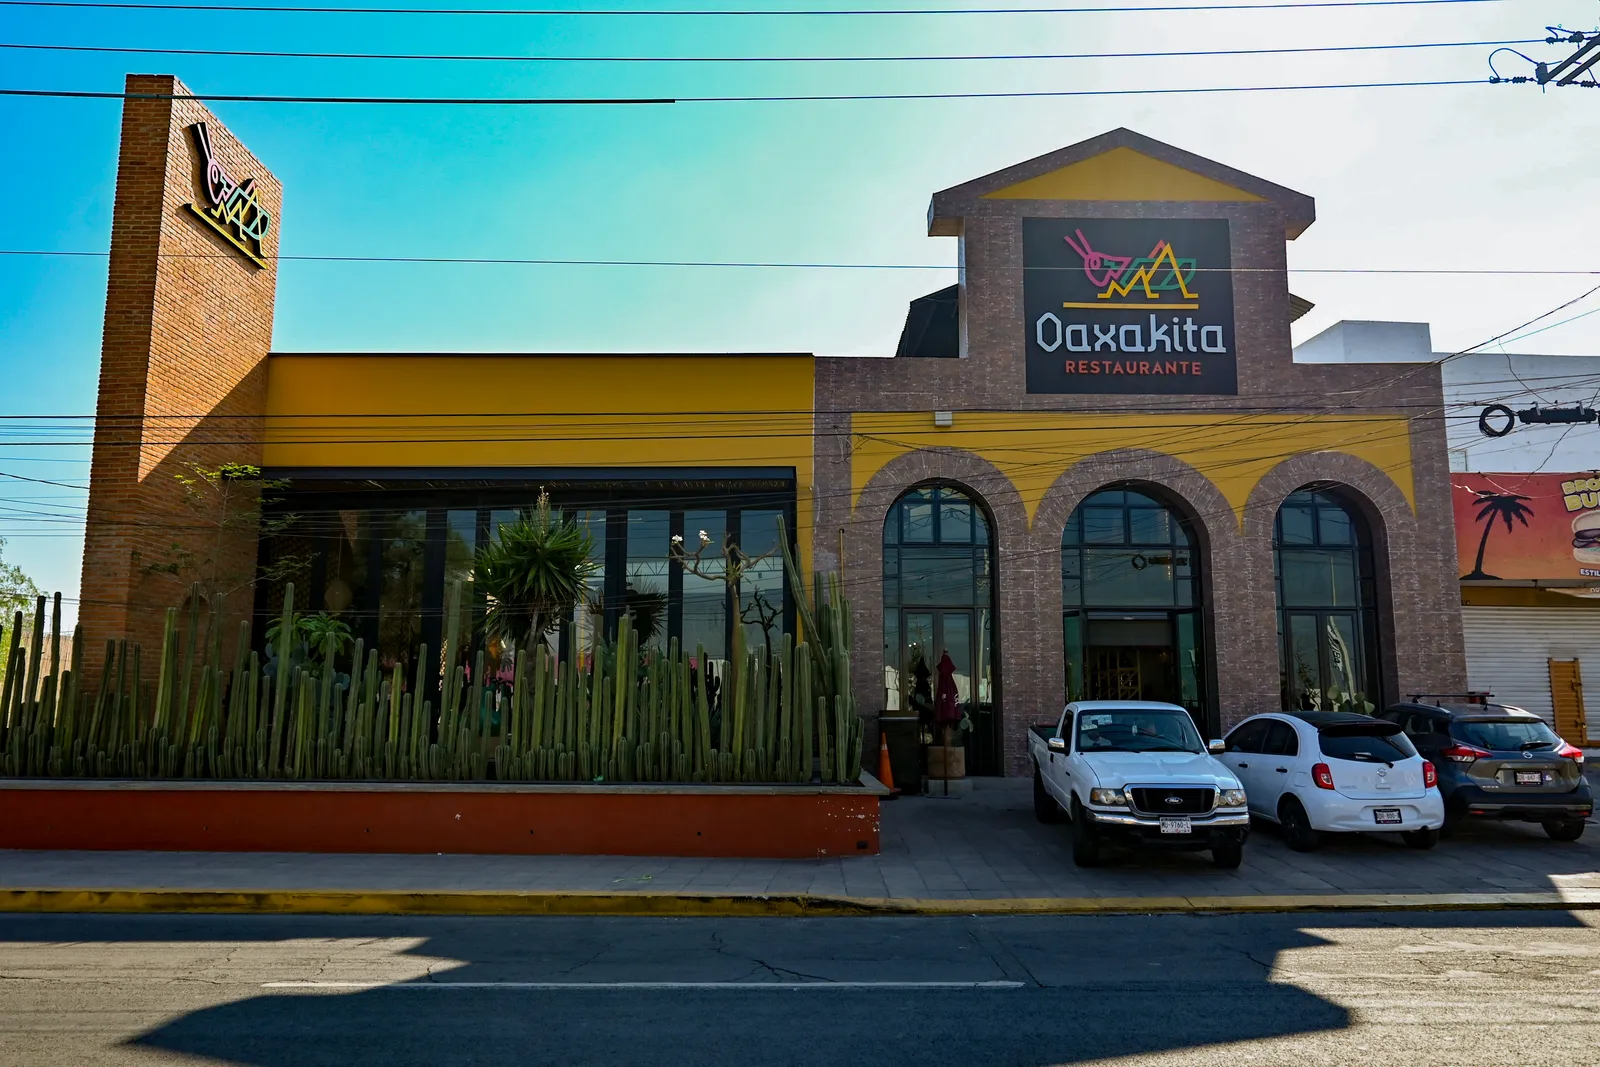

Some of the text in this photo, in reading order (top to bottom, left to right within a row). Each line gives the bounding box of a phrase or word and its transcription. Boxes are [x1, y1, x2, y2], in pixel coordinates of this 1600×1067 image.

[1036, 312, 1226, 353] Oaxakita
[1065, 360, 1202, 375] RESTAURANTE
[1564, 491, 1600, 512] BU
